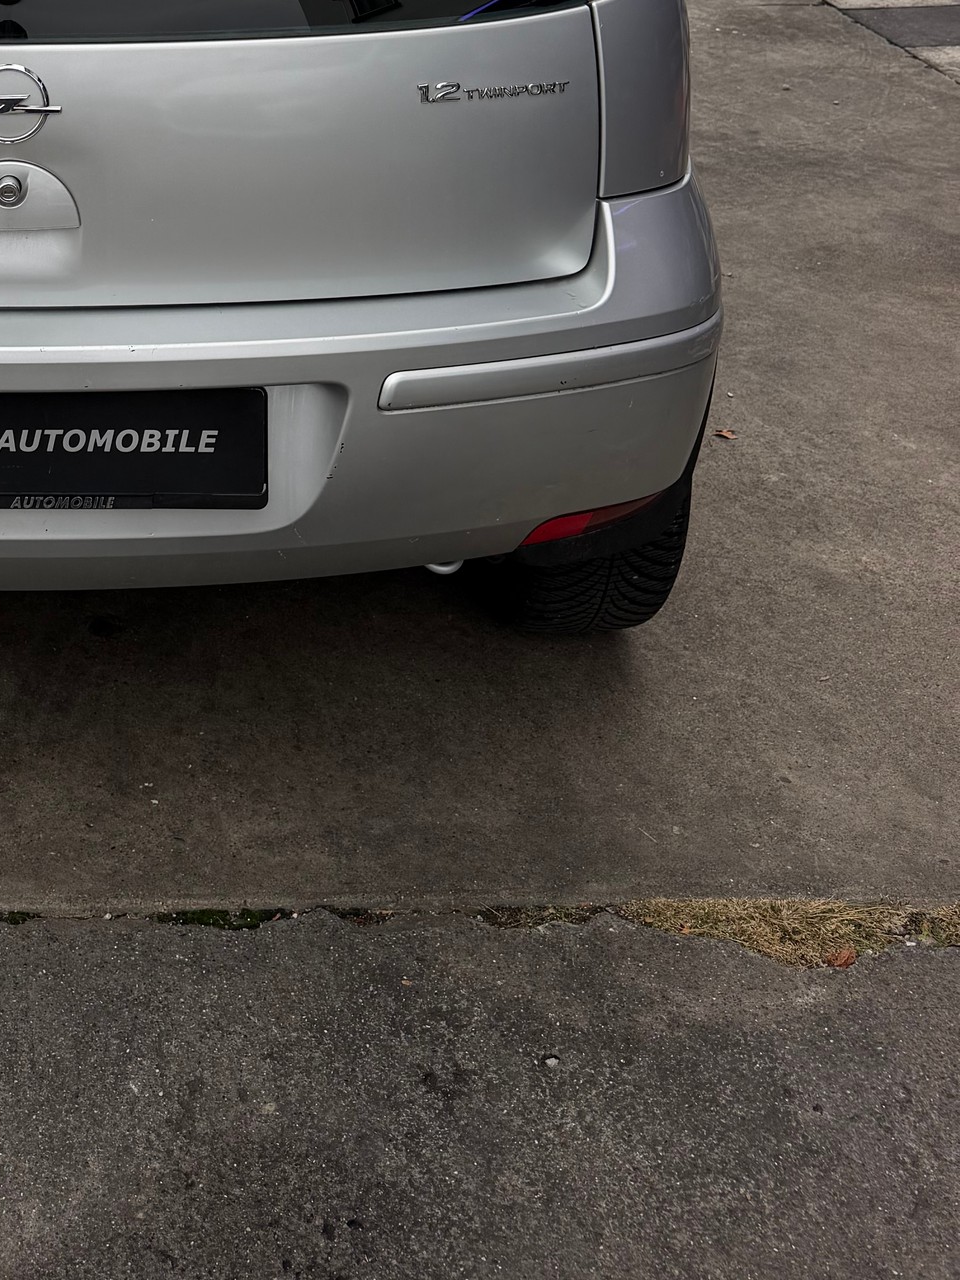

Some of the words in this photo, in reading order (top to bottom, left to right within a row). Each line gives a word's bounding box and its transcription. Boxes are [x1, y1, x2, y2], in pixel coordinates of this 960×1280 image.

[417, 81, 461, 104] 1.2
[462, 81, 570, 100] TWINPORT
[10, 496, 115, 509] AUTOMOBILE
